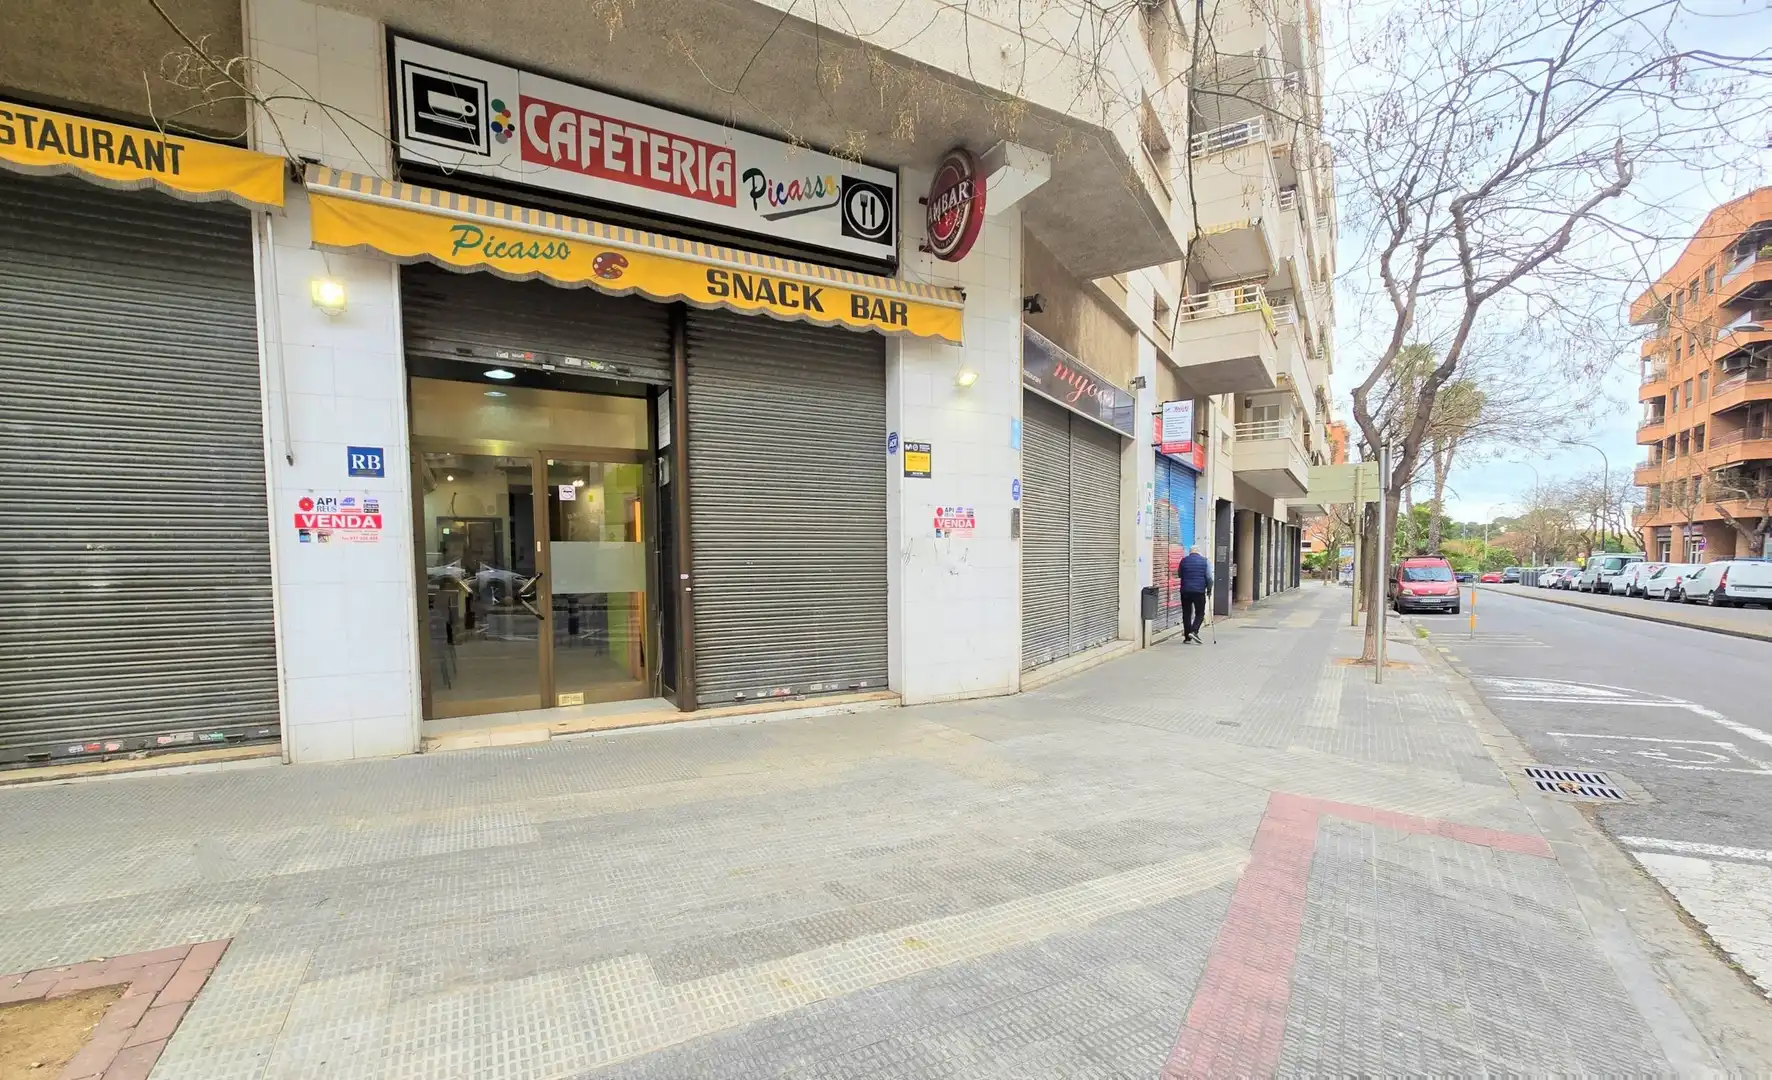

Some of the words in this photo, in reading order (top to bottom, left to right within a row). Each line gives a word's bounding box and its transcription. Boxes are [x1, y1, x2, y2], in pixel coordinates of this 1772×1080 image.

[0, 109, 185, 176] STAURANT
[525, 103, 733, 199] CAFETERIA
[742, 167, 837, 211] Picasso
[928, 181, 970, 225] AMBAR
[450, 224, 571, 260] Picasso
[706, 268, 825, 313] SNACK
[851, 293, 908, 327] BAR
[352, 454, 381, 470] RB
[301, 515, 377, 528] VENDA
[938, 520, 973, 528] VENDA
